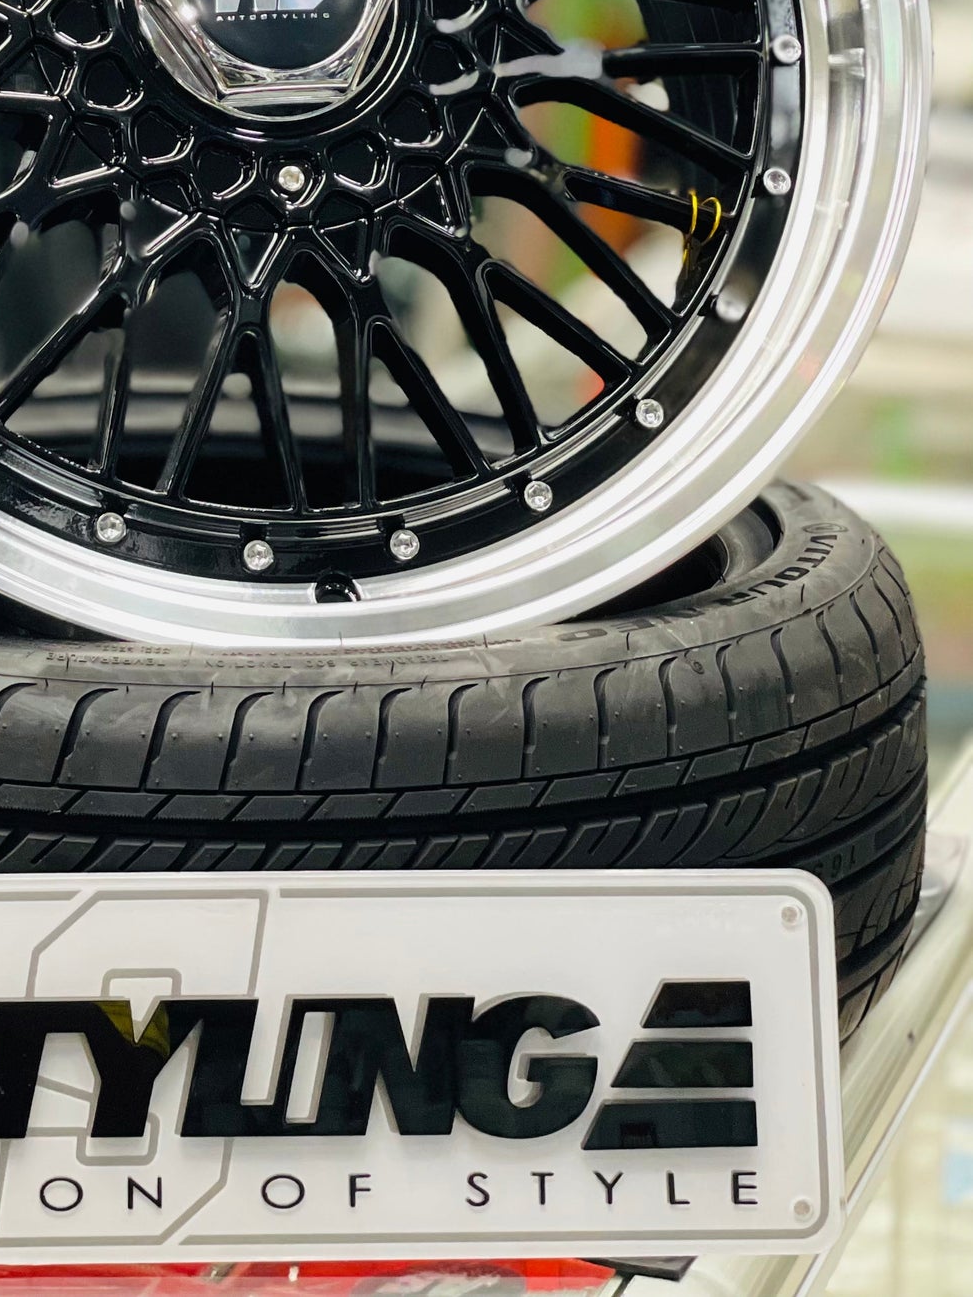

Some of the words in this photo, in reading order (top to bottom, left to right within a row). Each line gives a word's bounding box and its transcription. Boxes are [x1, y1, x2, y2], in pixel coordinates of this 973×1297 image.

[215, 12, 330, 22] AUTOSTYLING
[713, 533, 839, 608] VITOUR
[44, 651, 166, 668] TEMPERATURE
[203, 659, 292, 670] TRACTION
[262, 1172, 372, 1209] OF
[466, 1171, 759, 1207] STYLE
